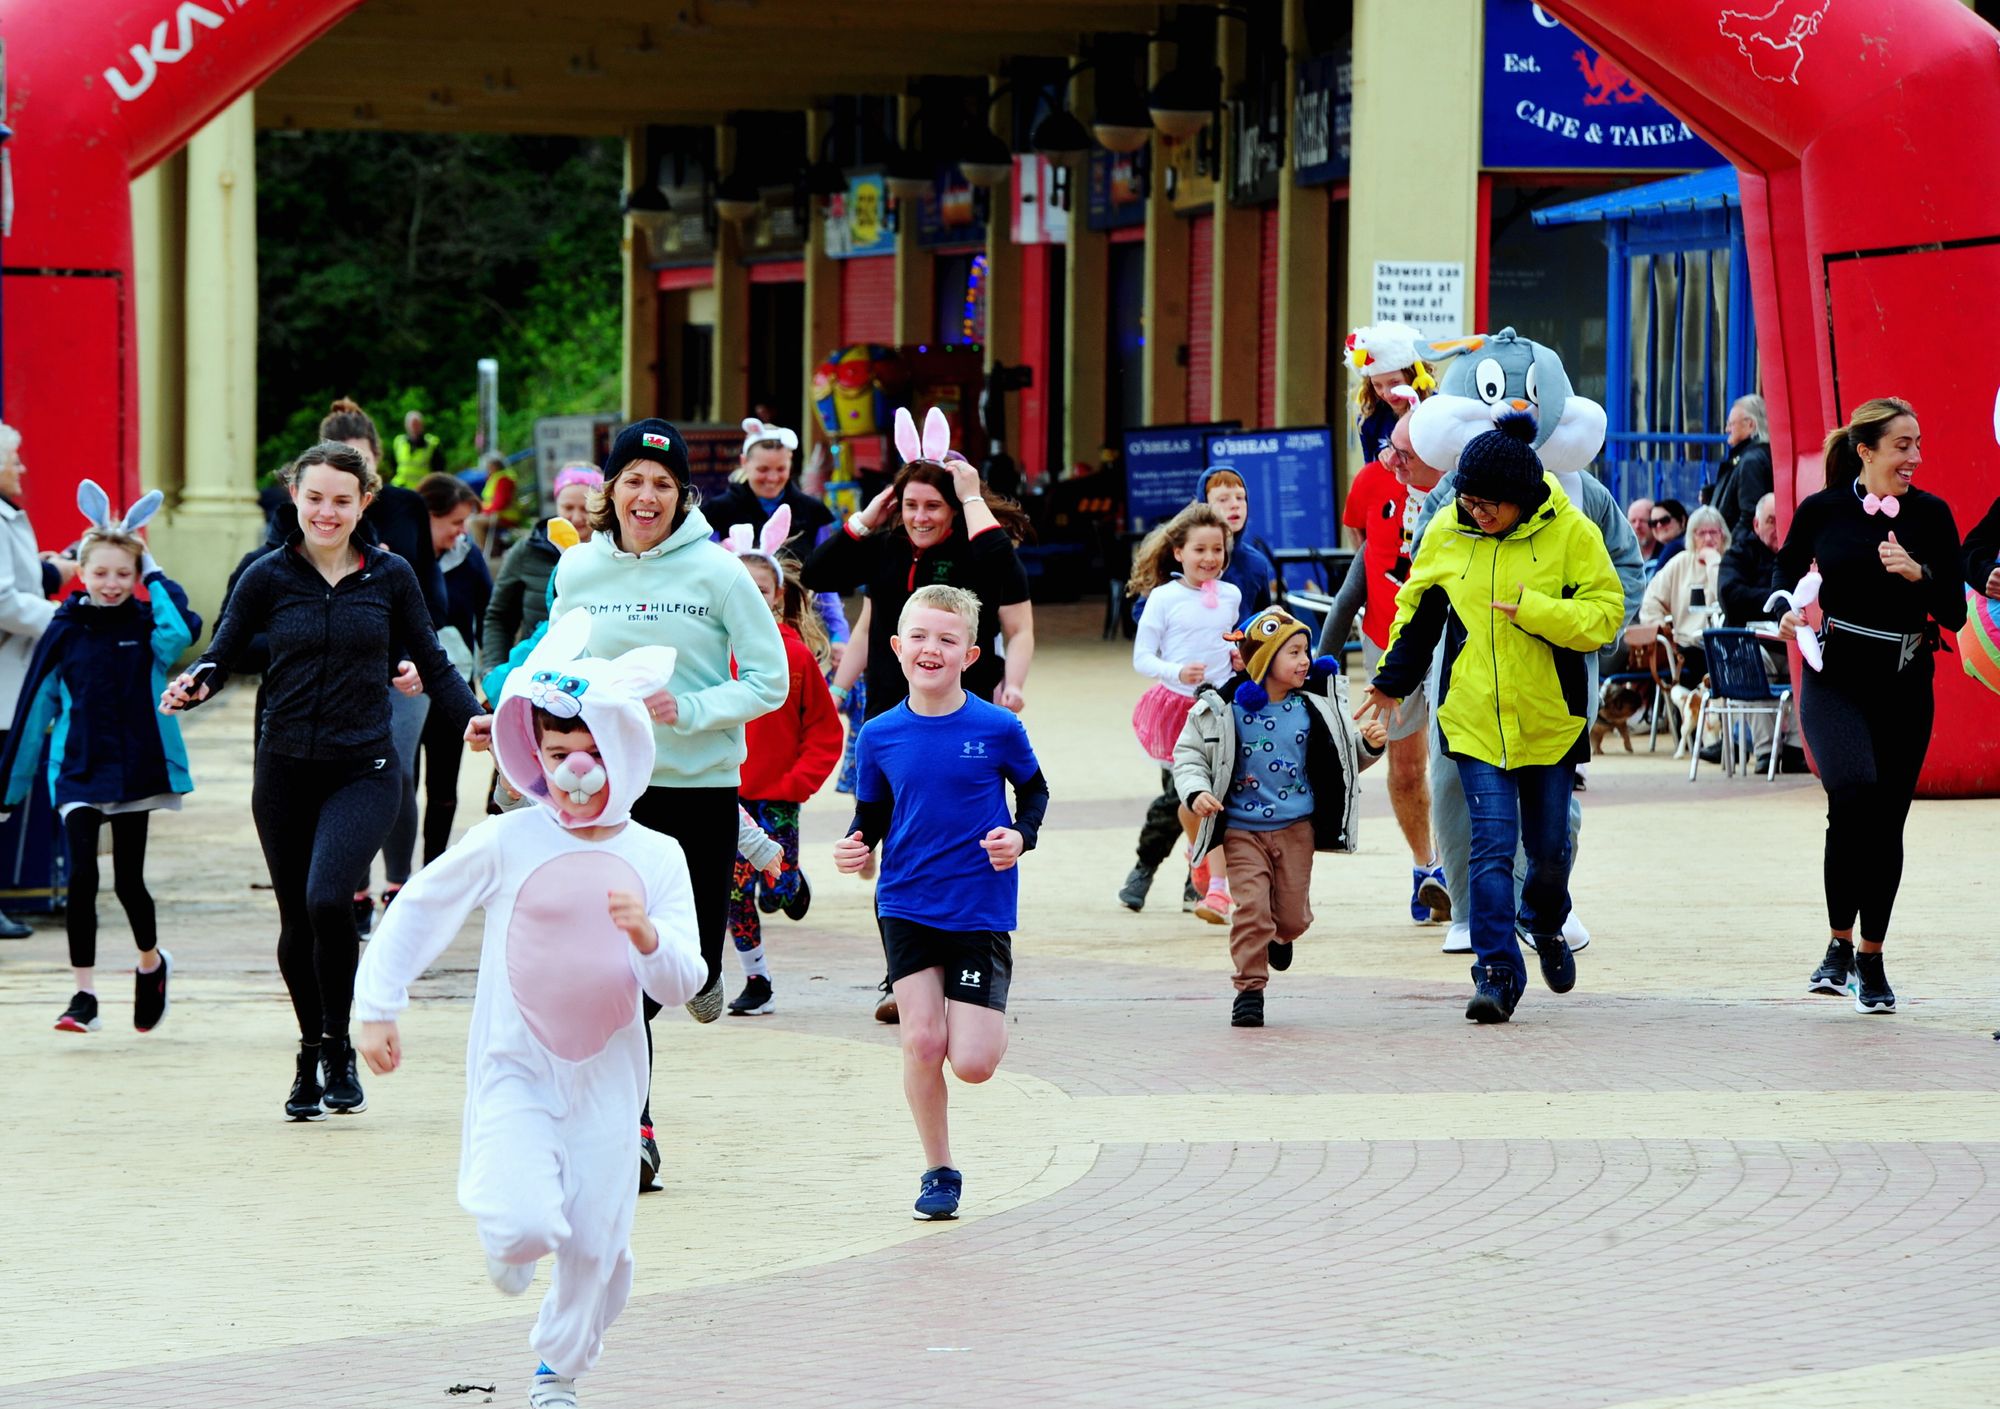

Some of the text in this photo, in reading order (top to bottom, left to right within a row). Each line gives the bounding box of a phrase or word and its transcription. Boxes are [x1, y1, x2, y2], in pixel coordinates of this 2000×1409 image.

[103, 1, 225, 101] UKA
[1503, 53, 1541, 73] Est.
[1516, 100, 1694, 146] CAFE & TAKEA
[1378, 265, 1459, 277] Showers can
[1377, 281, 1451, 292] be found at
[1377, 296, 1443, 308] the end of
[1377, 312, 1455, 322] the Western
[1128, 440, 1192, 456] O'SHEAS
[1211, 438, 1279, 457] O'SHEAS
[583, 604, 632, 615] OMMY
